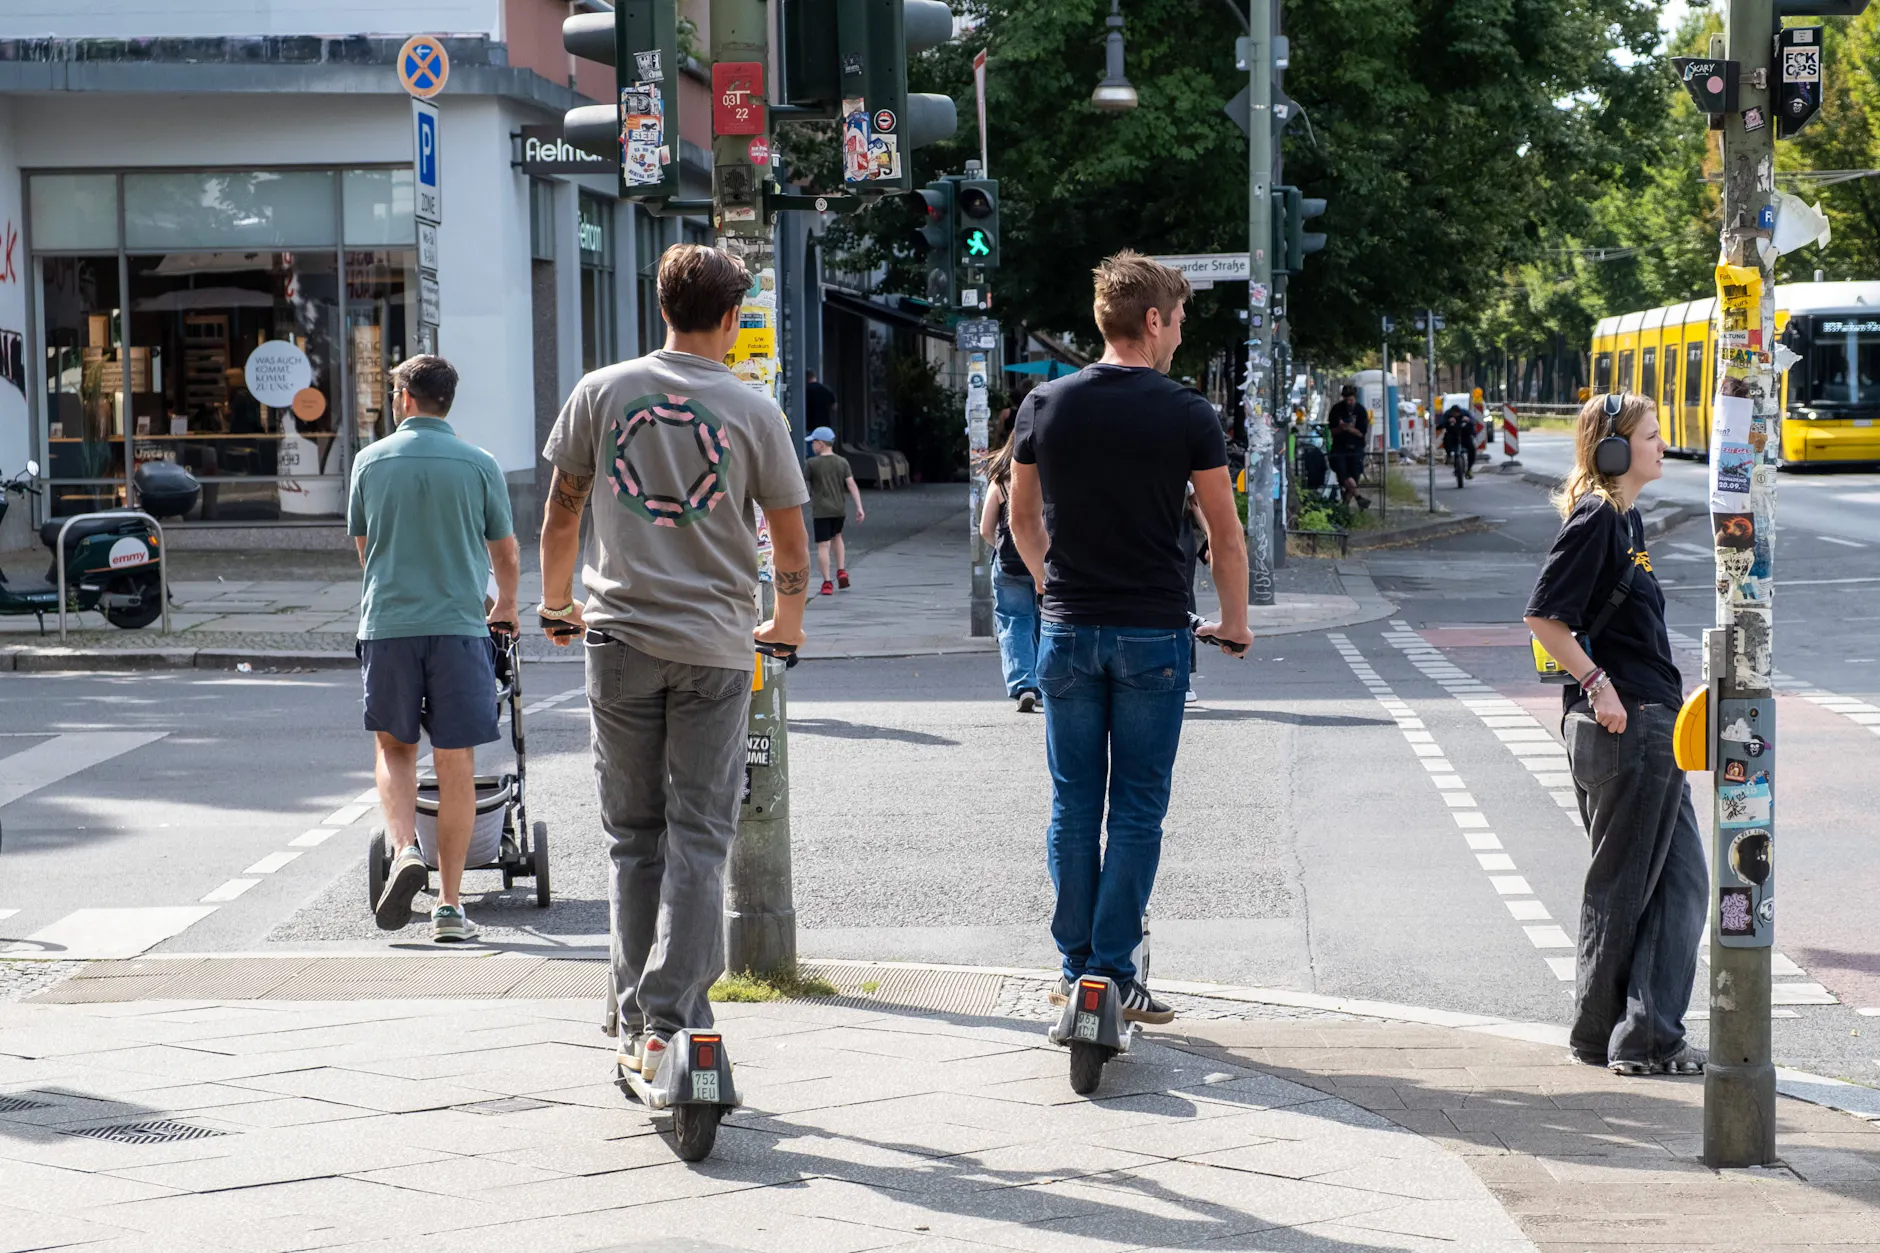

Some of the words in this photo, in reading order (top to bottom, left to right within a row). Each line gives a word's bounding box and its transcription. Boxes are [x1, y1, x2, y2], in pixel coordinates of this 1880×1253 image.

[421, 192, 435, 216] ZONE
[1212, 260, 1245, 272] Straße
[255, 356, 275, 364] WAS
[277, 356, 302, 364] AUCH
[255, 374, 286, 382] KOMM
[256, 383, 265, 391] ZU
[112, 550, 146, 566] emmy
[1078, 1013, 1096, 1025] 961
[695, 1073, 716, 1086] 752
